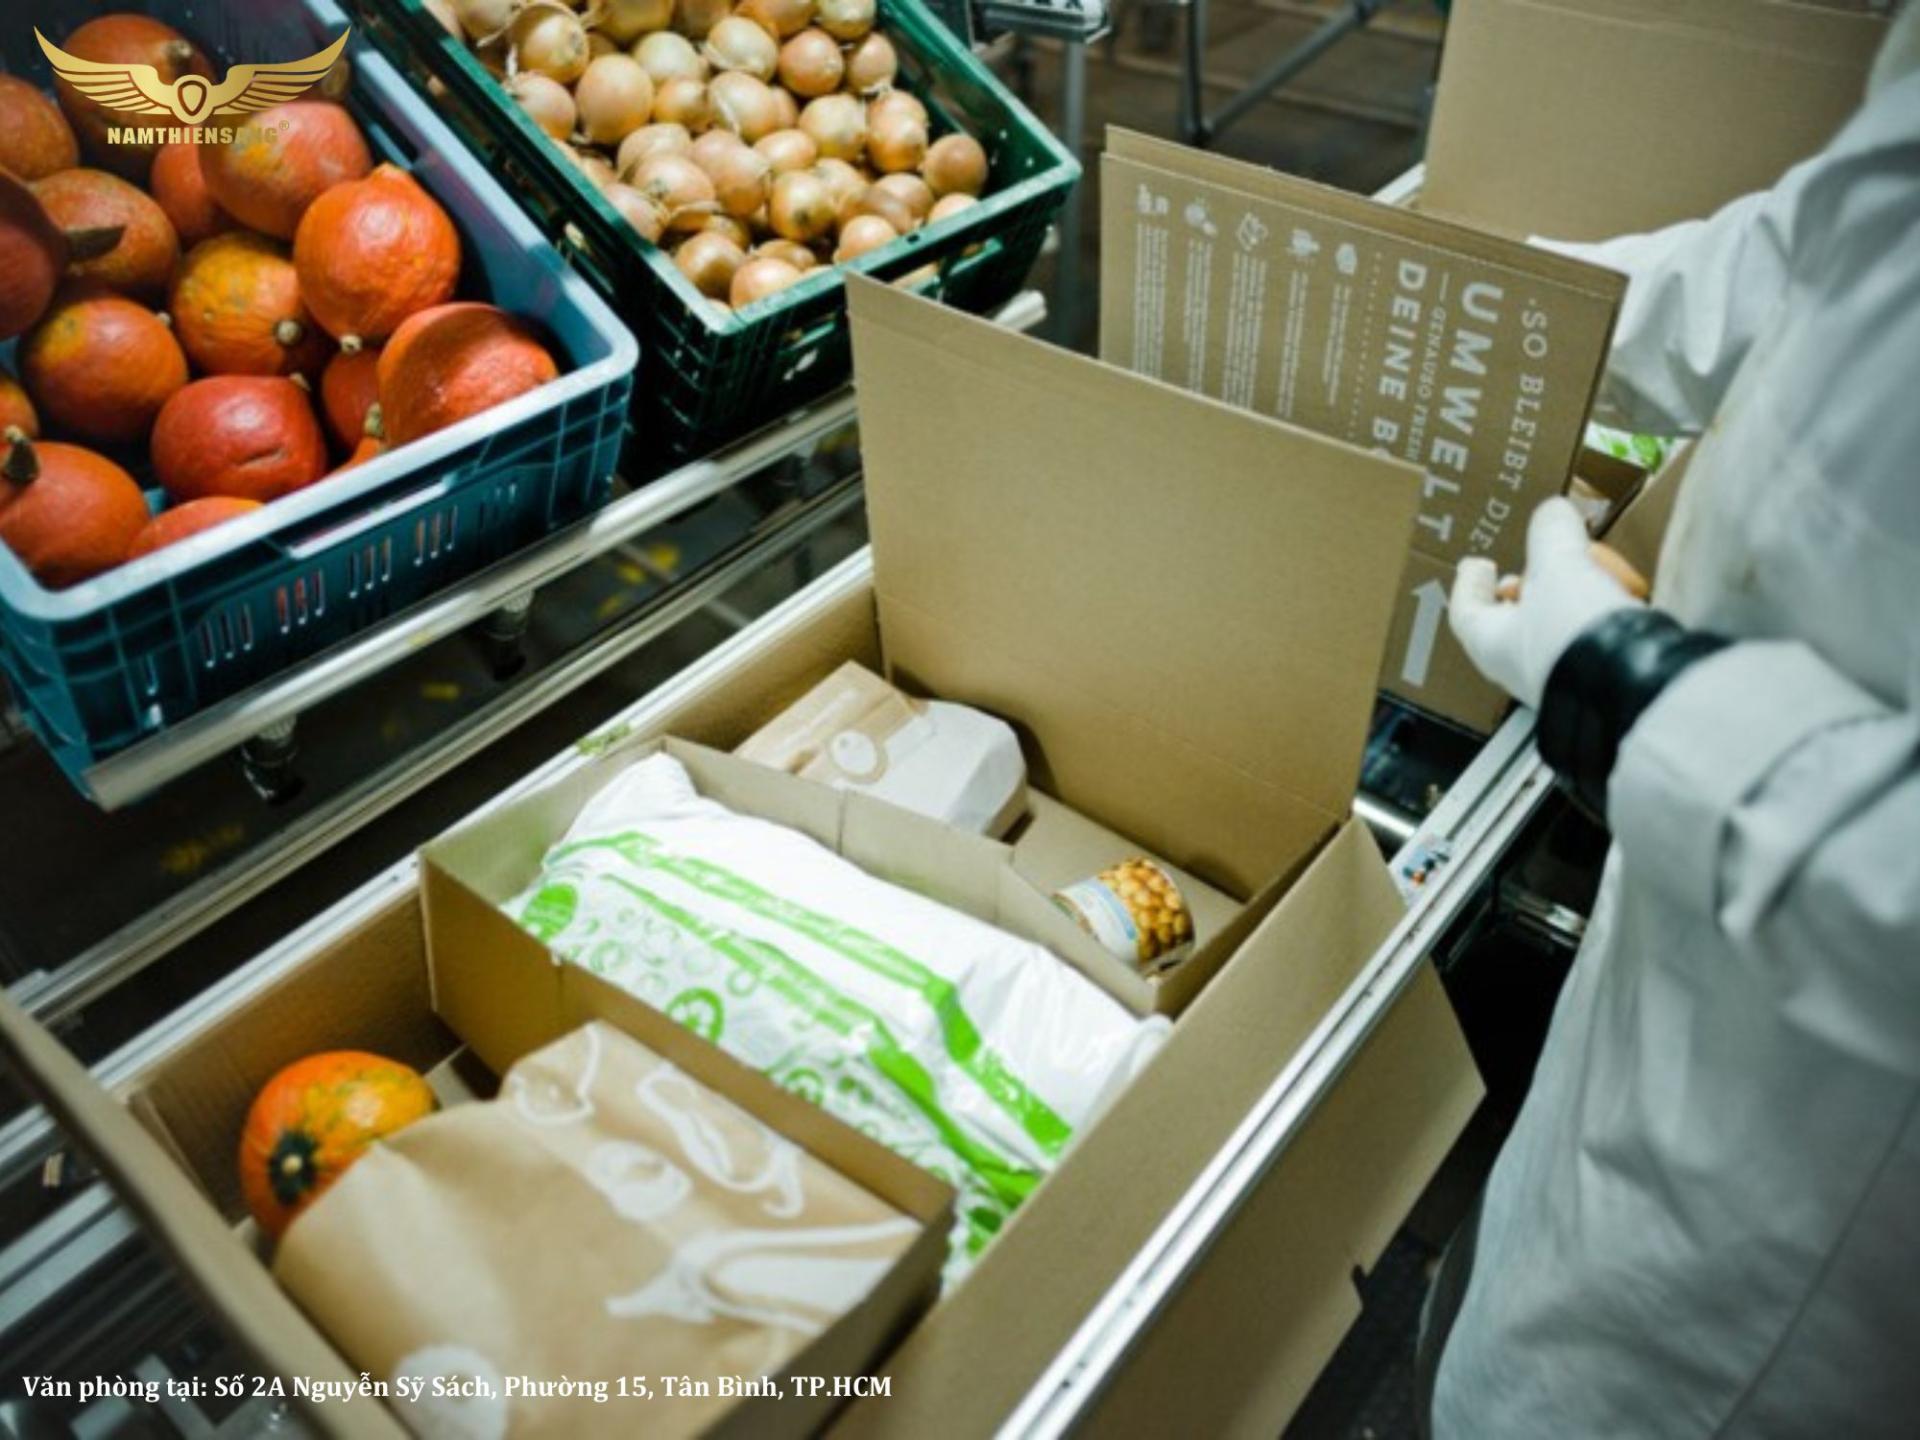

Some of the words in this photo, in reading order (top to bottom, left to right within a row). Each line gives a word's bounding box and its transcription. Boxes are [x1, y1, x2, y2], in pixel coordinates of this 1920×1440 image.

[1378, 259, 1427, 401] DEINE
[1417, 307, 1447, 399] GENAUSO
[1417, 281, 1504, 542] UMWELT
[1497, 374, 1545, 491] BLEIBT
